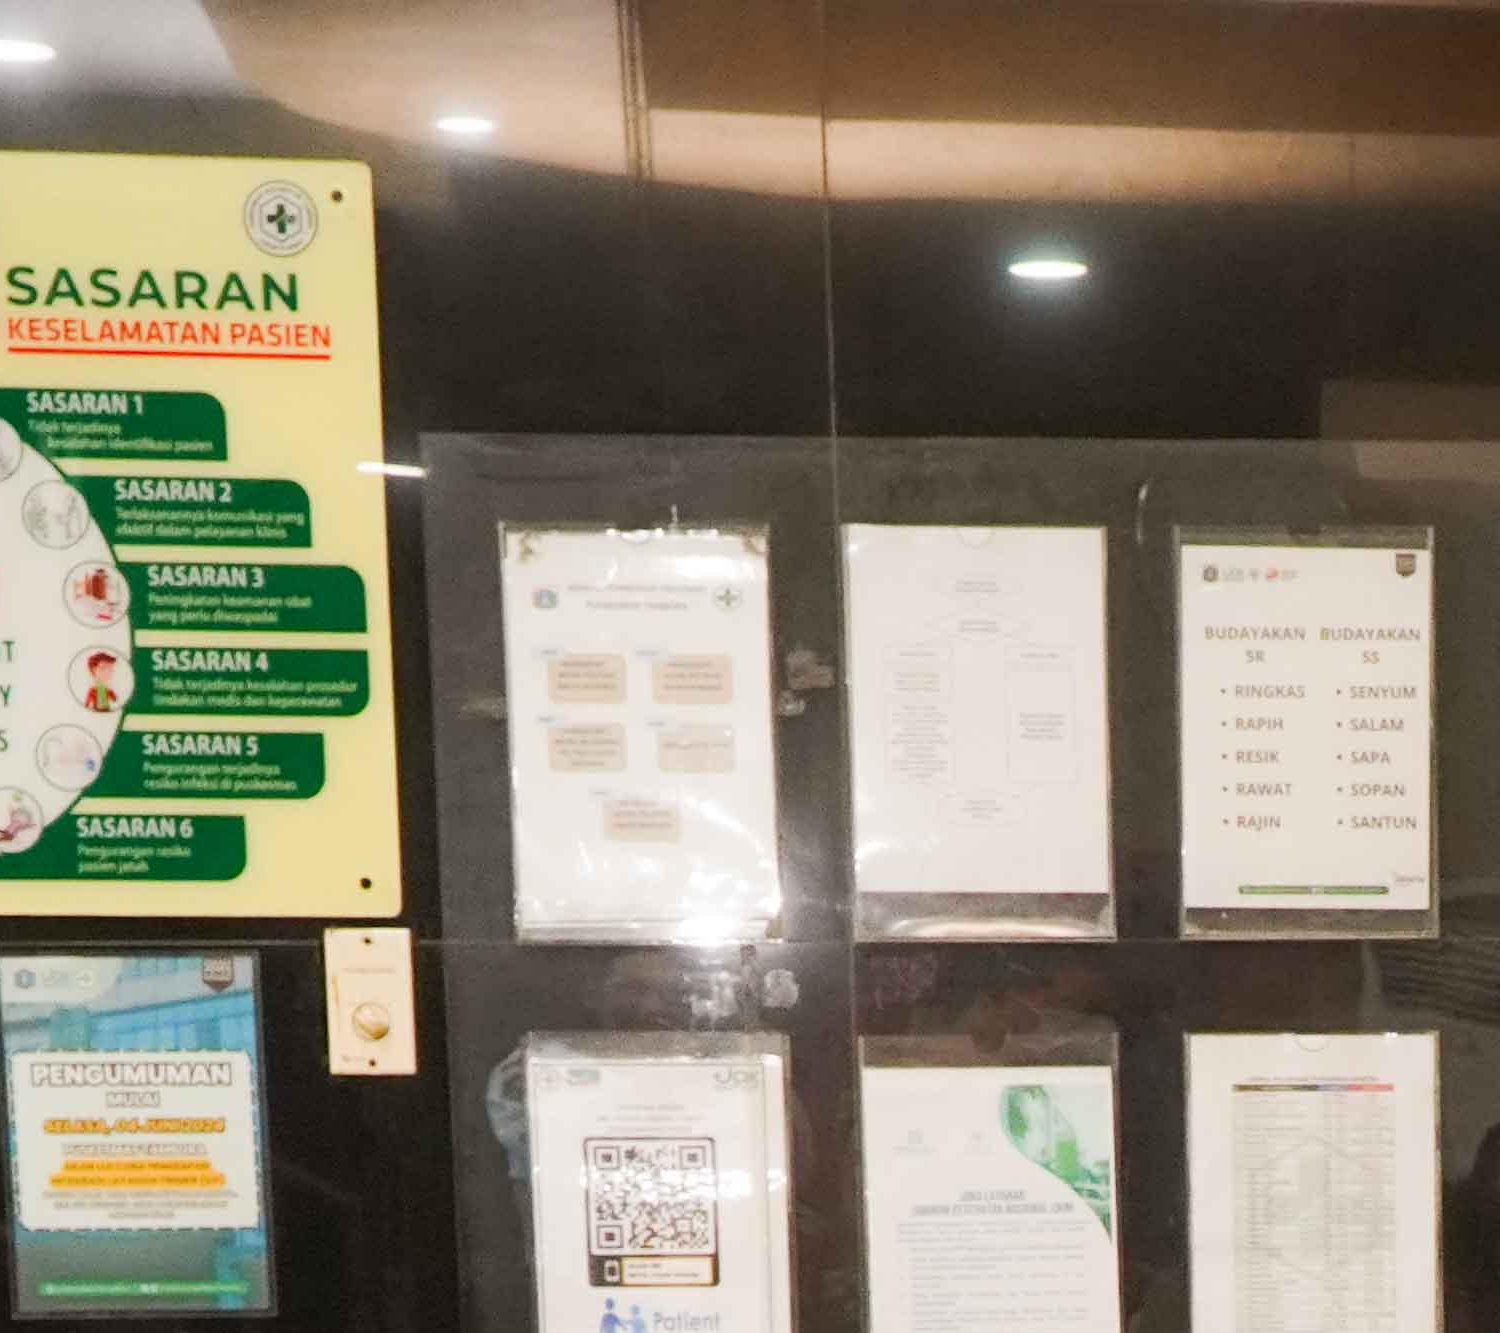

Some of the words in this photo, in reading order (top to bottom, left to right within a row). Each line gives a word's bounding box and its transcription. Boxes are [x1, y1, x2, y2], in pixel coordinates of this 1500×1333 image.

[6, 266, 300, 312] SASARAN
[8, 318, 220, 346] KESELAMATAN
[231, 322, 331, 348] PASIEN
[26, 392, 128, 415] SASARAN
[133, 395, 144, 415] 1
[114, 479, 216, 502] SASARAN
[219, 482, 232, 502] 2
[148, 565, 247, 588] SASARAN
[252, 567, 265, 588] 3
[1204, 625, 1306, 642] BUDAYAKAN
[1320, 626, 1421, 642] BUDAYAKAN
[151, 651, 251, 672] SASARAN
[255, 653, 268, 672] 4
[1234, 685, 1306, 699] RINGKAS
[1349, 685, 1417, 699] SENYUM
[1235, 718, 1284, 732] RAPIH
[1349, 718, 1405, 732] SALAM
[142, 734, 242, 756] SASARAN
[246, 736, 260, 756] 5
[1236, 750, 1280, 765] RESIK
[1350, 751, 1391, 765] SAPA
[1236, 783, 1293, 797] RAWAT
[1350, 783, 1406, 798] SOPAN
[76, 817, 177, 839] SASARAN
[180, 819, 193, 839] 6
[1236, 815, 1281, 831] RAJIN
[1350, 815, 1418, 830] SANTUN
[31, 1062, 232, 1088] PENGUMUMAN
